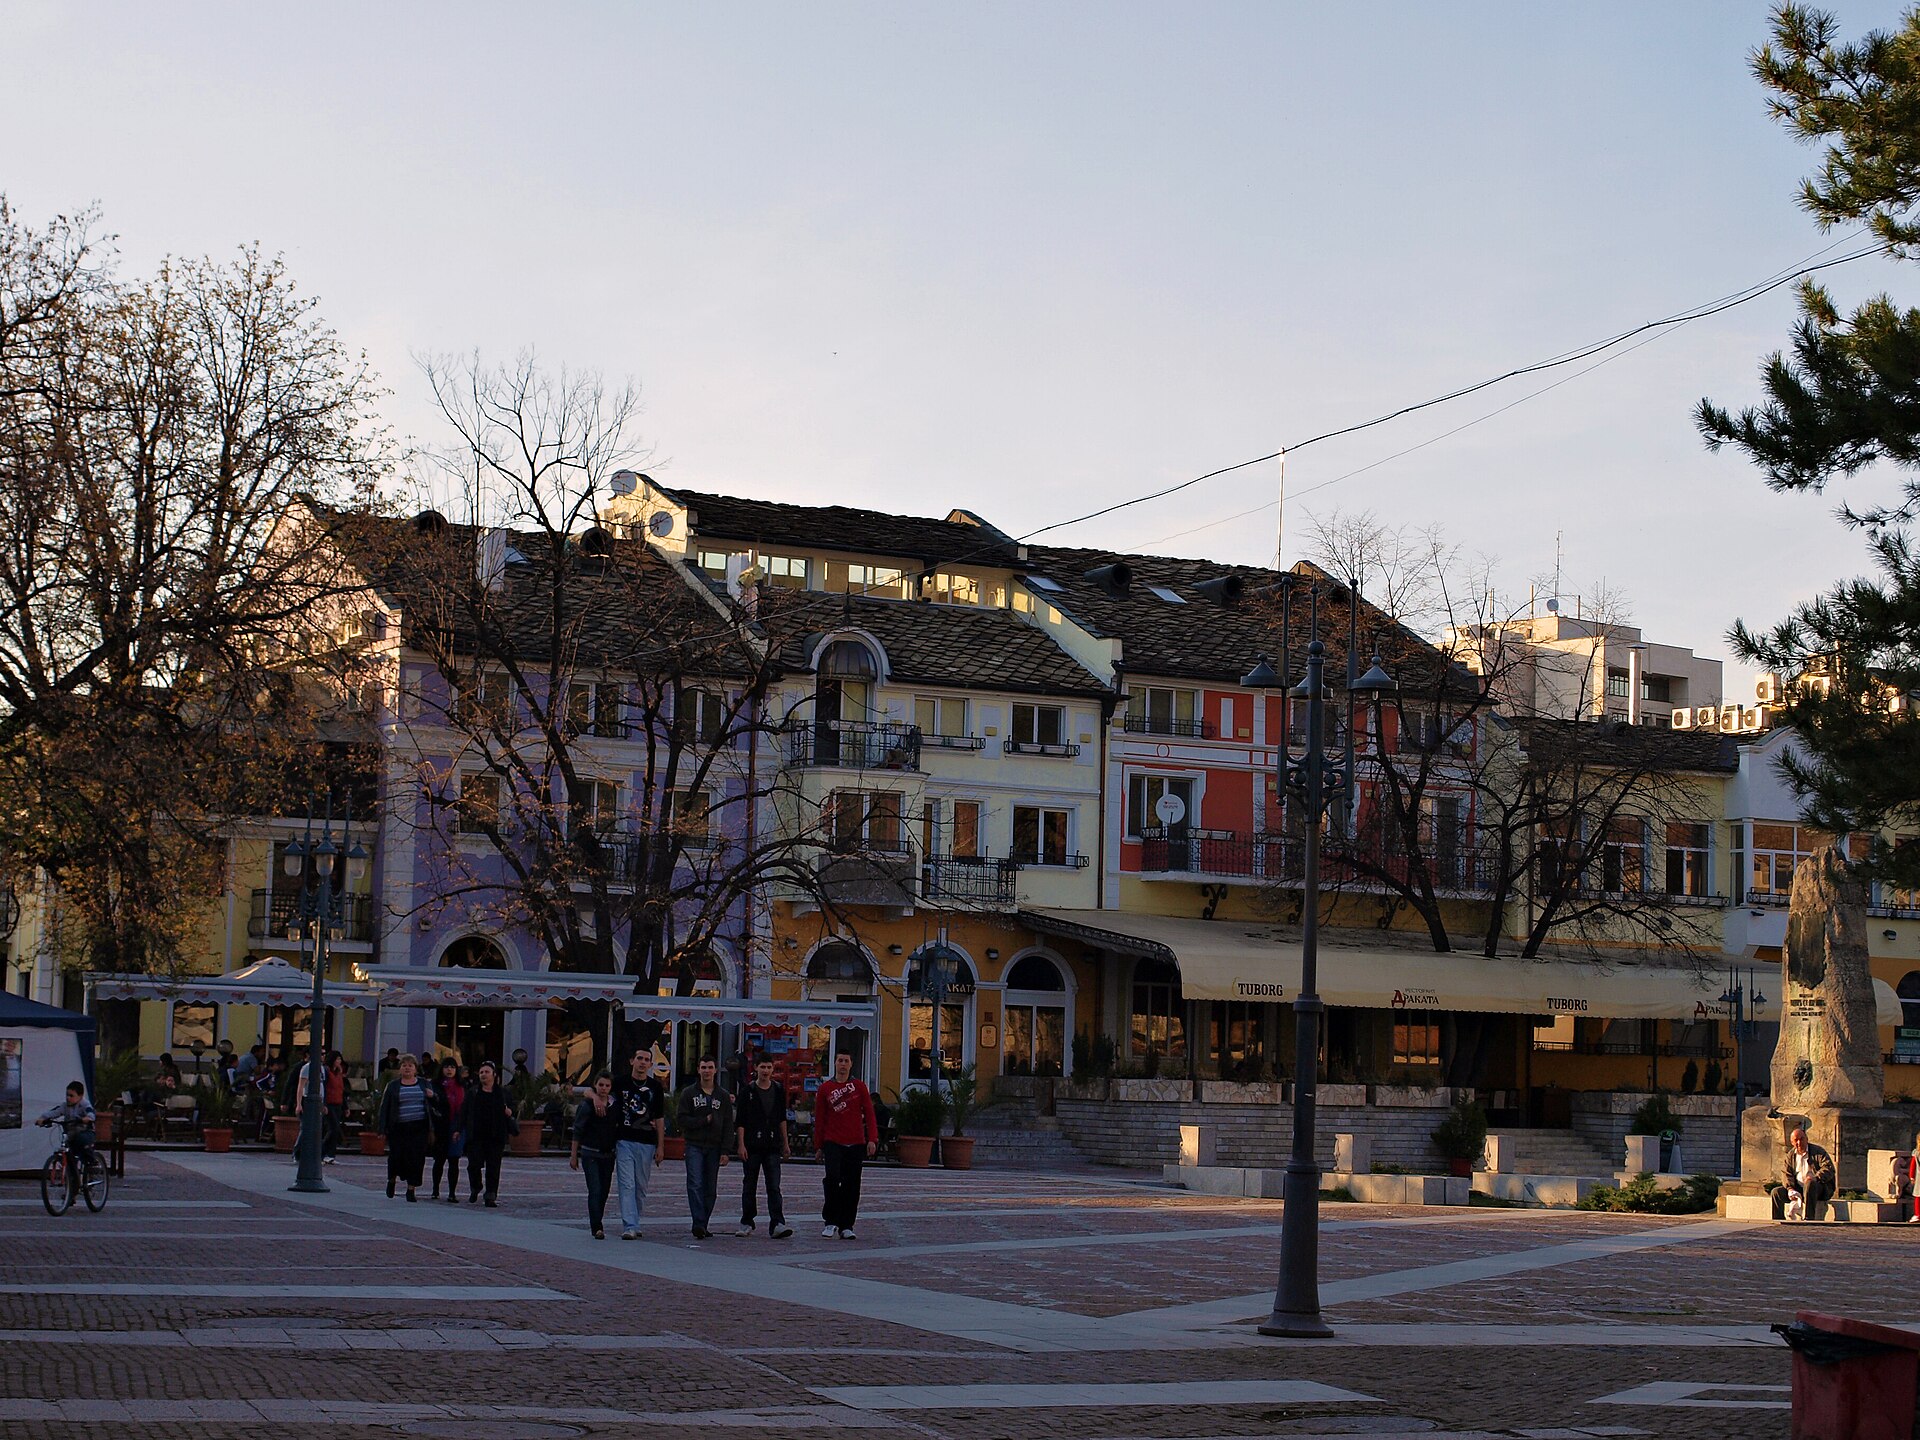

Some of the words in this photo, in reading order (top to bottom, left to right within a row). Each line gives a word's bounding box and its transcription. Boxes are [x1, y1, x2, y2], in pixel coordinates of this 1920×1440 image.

[1238, 983, 1283, 996] TUBORG
[1391, 989, 1439, 1007] ДРАКАТА
[1546, 998, 1588, 1010] TUBORG
